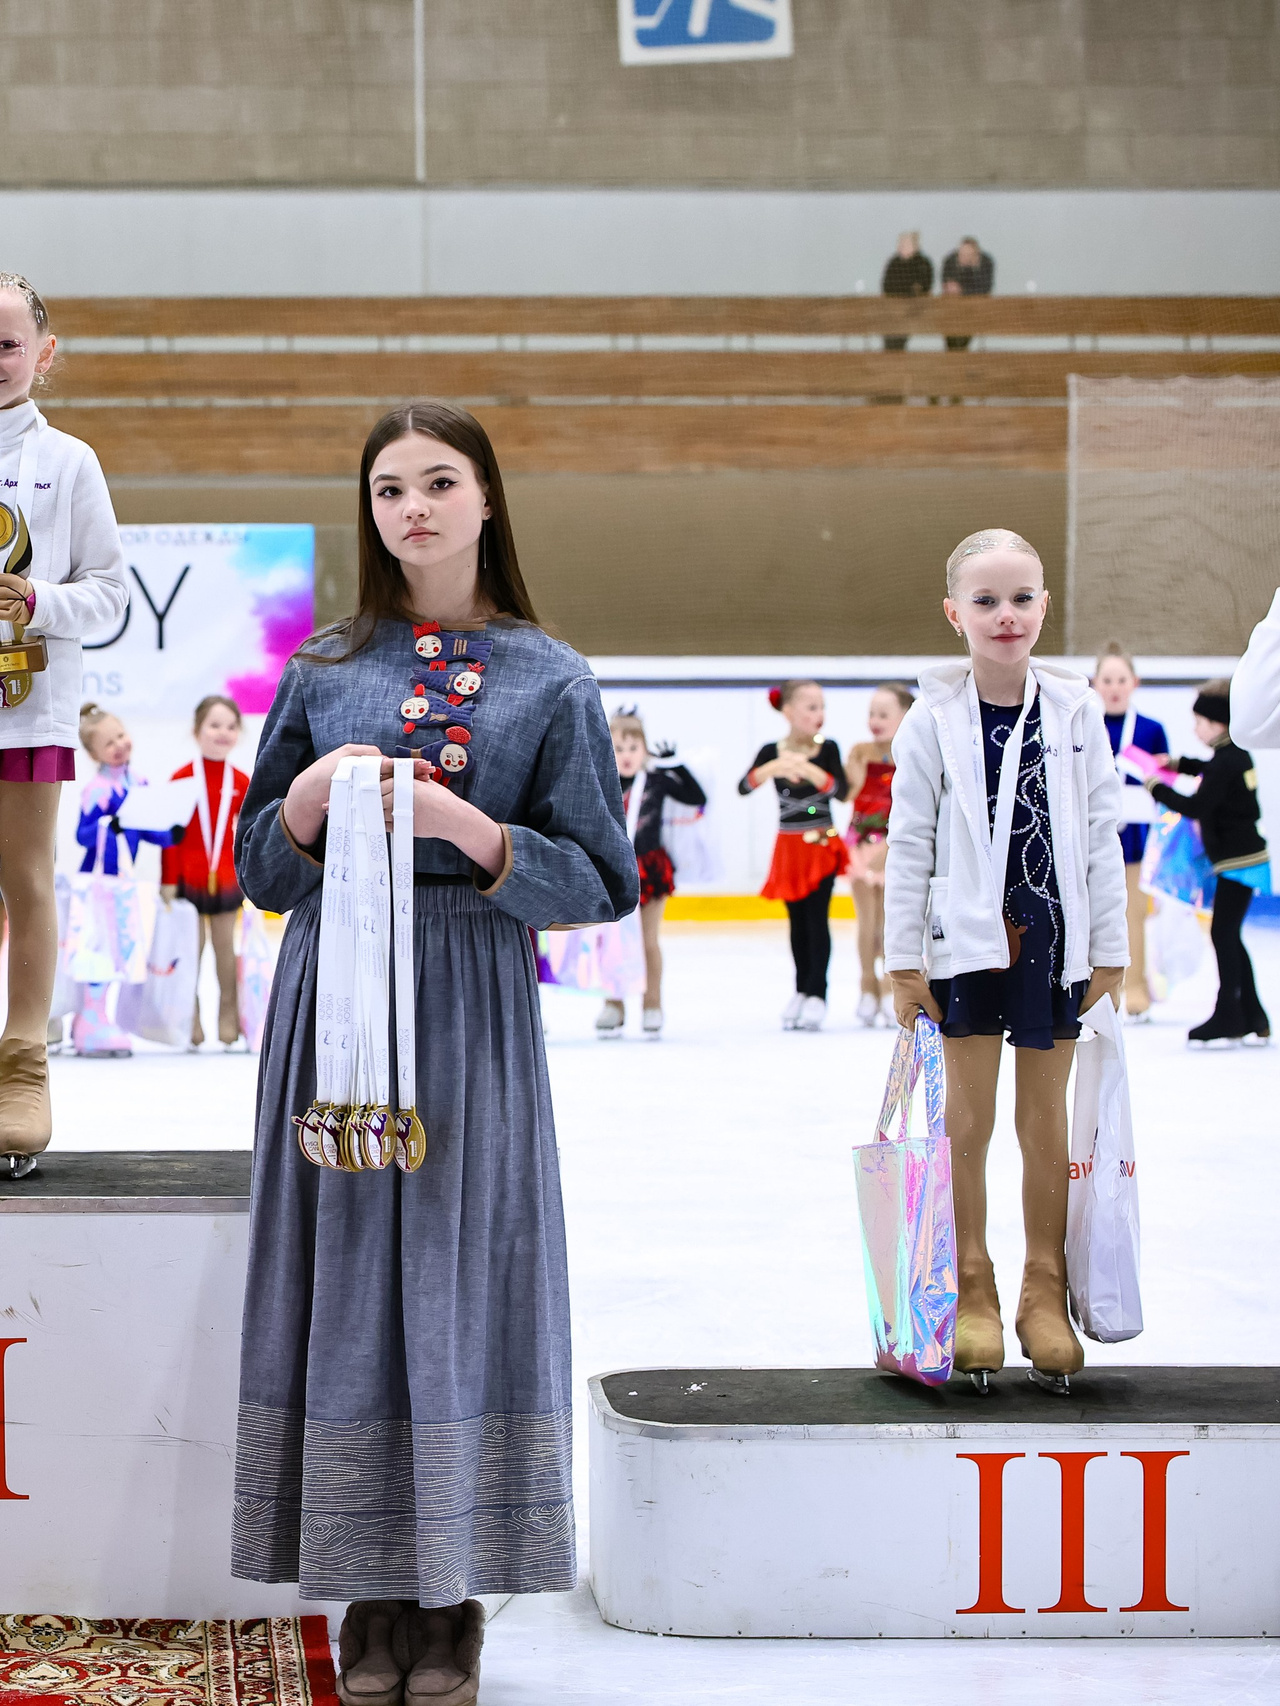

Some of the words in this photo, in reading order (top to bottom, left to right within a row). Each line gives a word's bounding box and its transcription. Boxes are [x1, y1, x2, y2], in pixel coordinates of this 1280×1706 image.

[4, 478, 52, 490] Архльск
[8, 680, 16, 694] 1
[403, 862, 411, 890] КУБОК
[383, 1136, 388, 1152] 1
[409, 1140, 414, 1157] 1
[956, 1450, 1190, 1614] III
